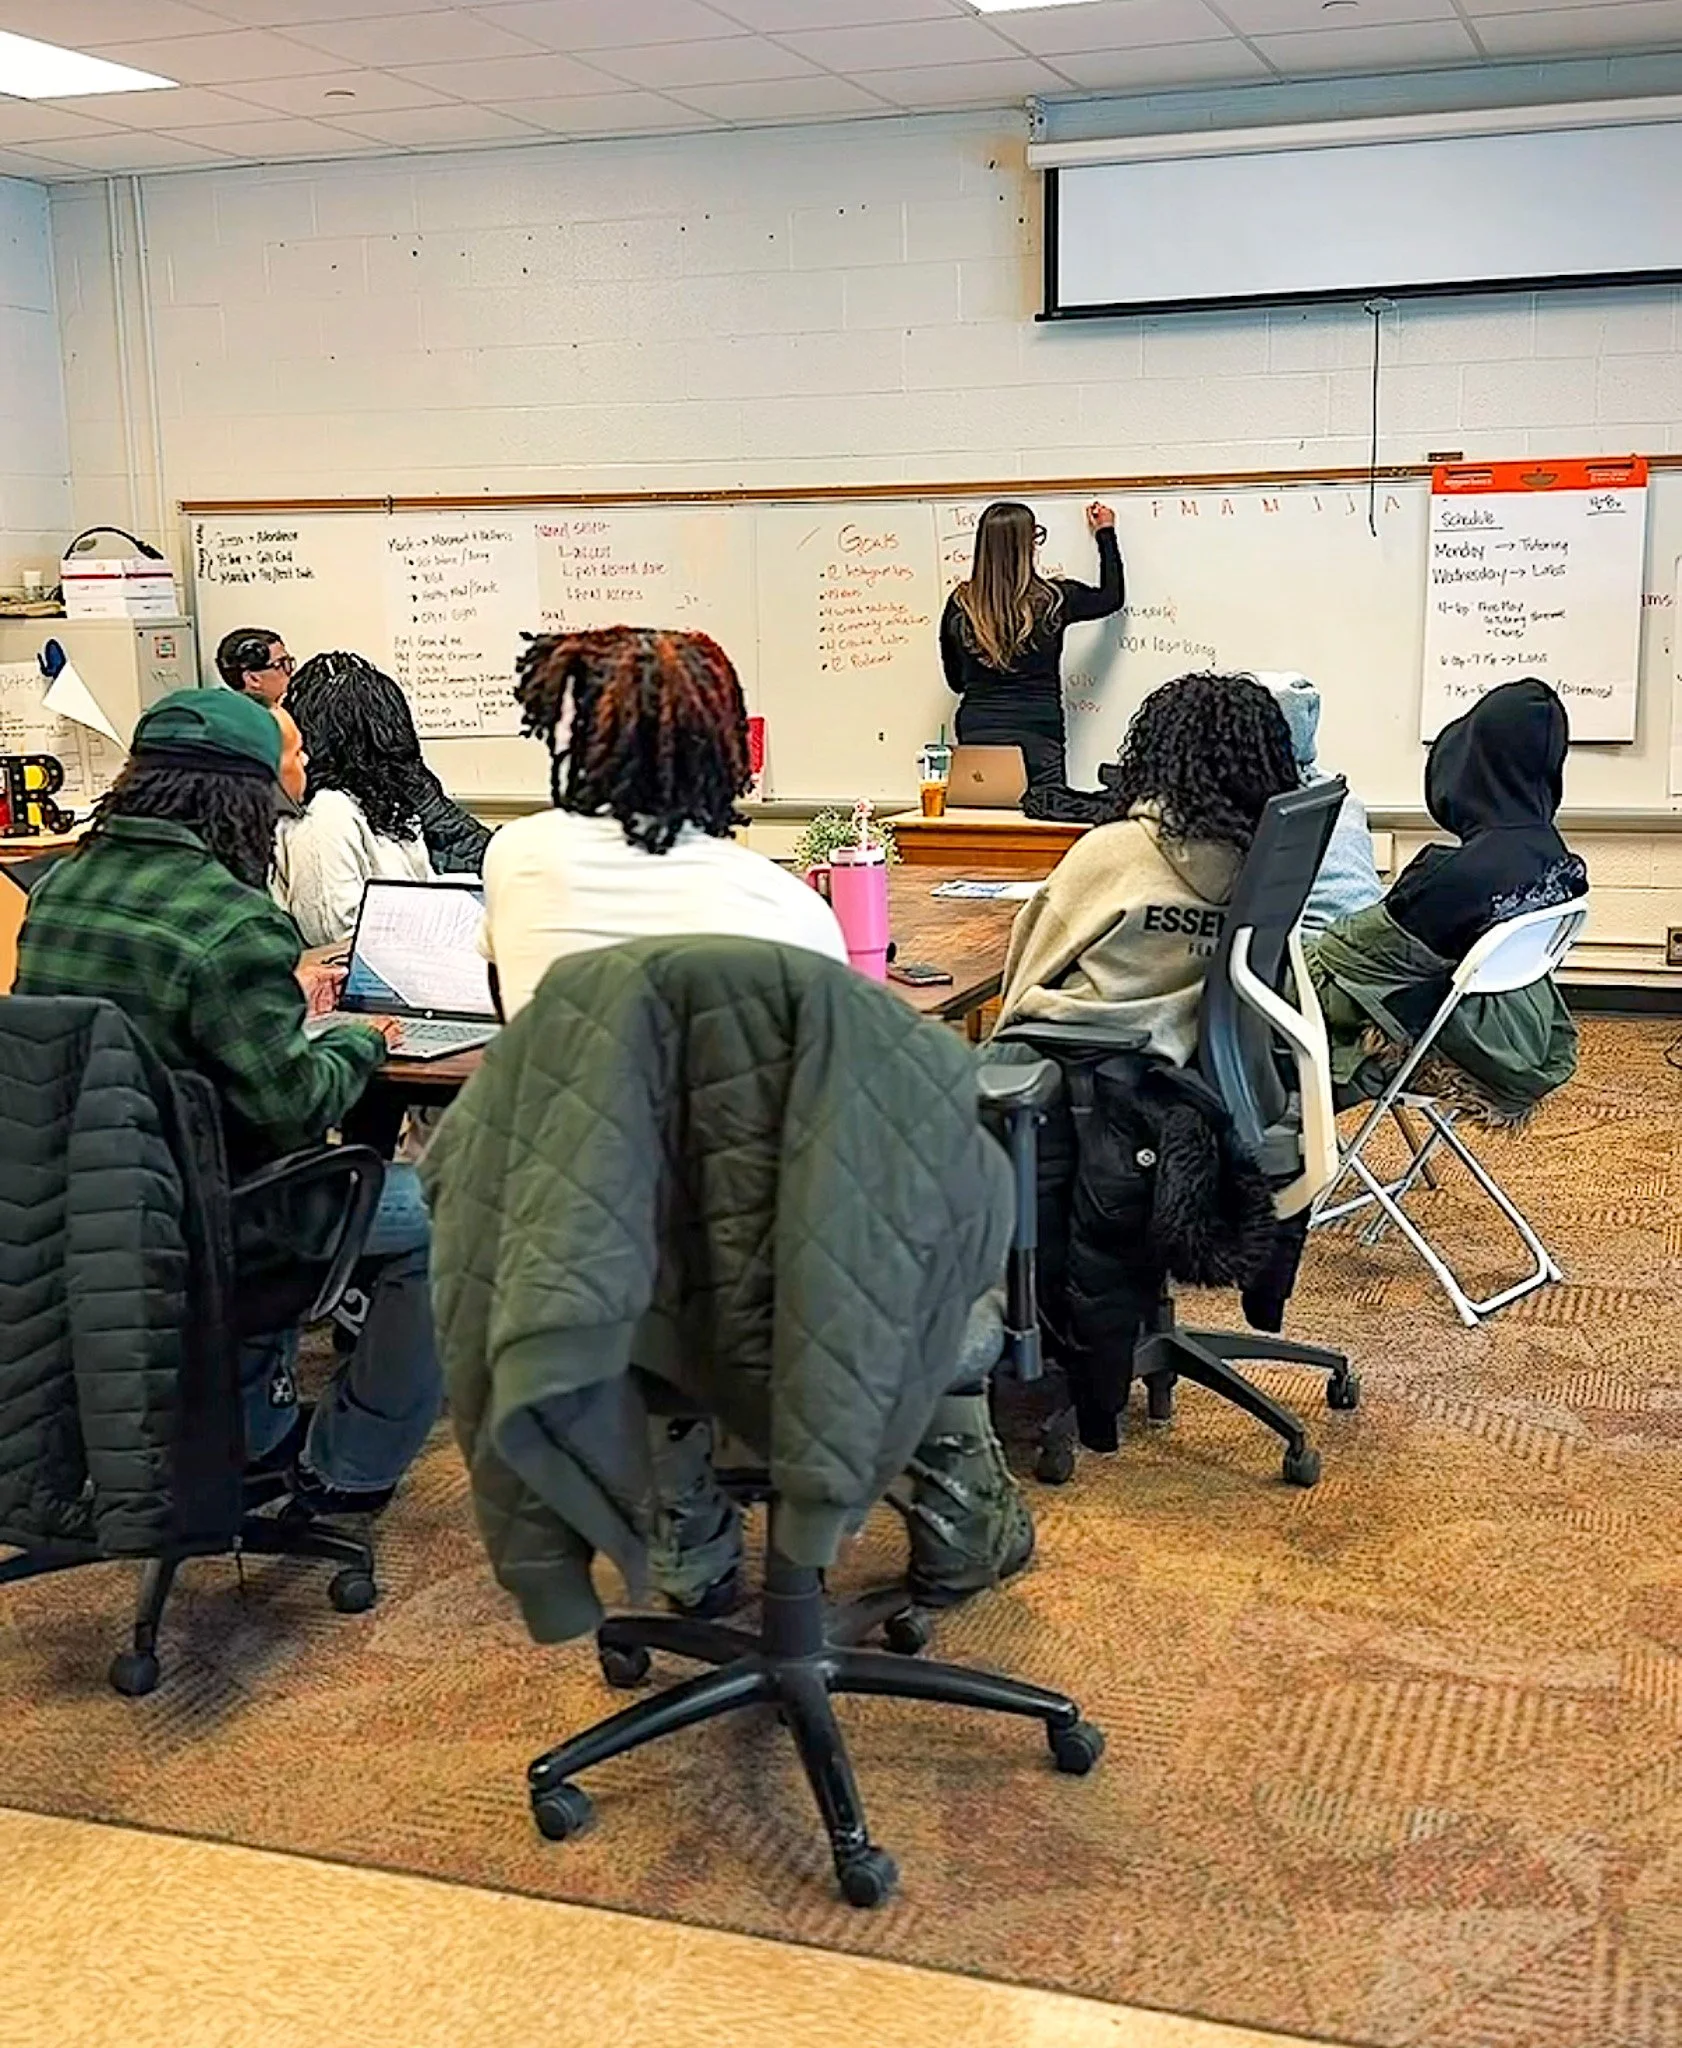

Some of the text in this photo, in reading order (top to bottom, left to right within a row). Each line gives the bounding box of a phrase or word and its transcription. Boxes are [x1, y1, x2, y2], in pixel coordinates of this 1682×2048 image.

[1180, 499, 1199, 516] M
[1221, 498, 1235, 516] A
[1384, 495, 1401, 514] A
[1441, 509, 1496, 528] Schedule
[1434, 541, 1486, 561] Monday
